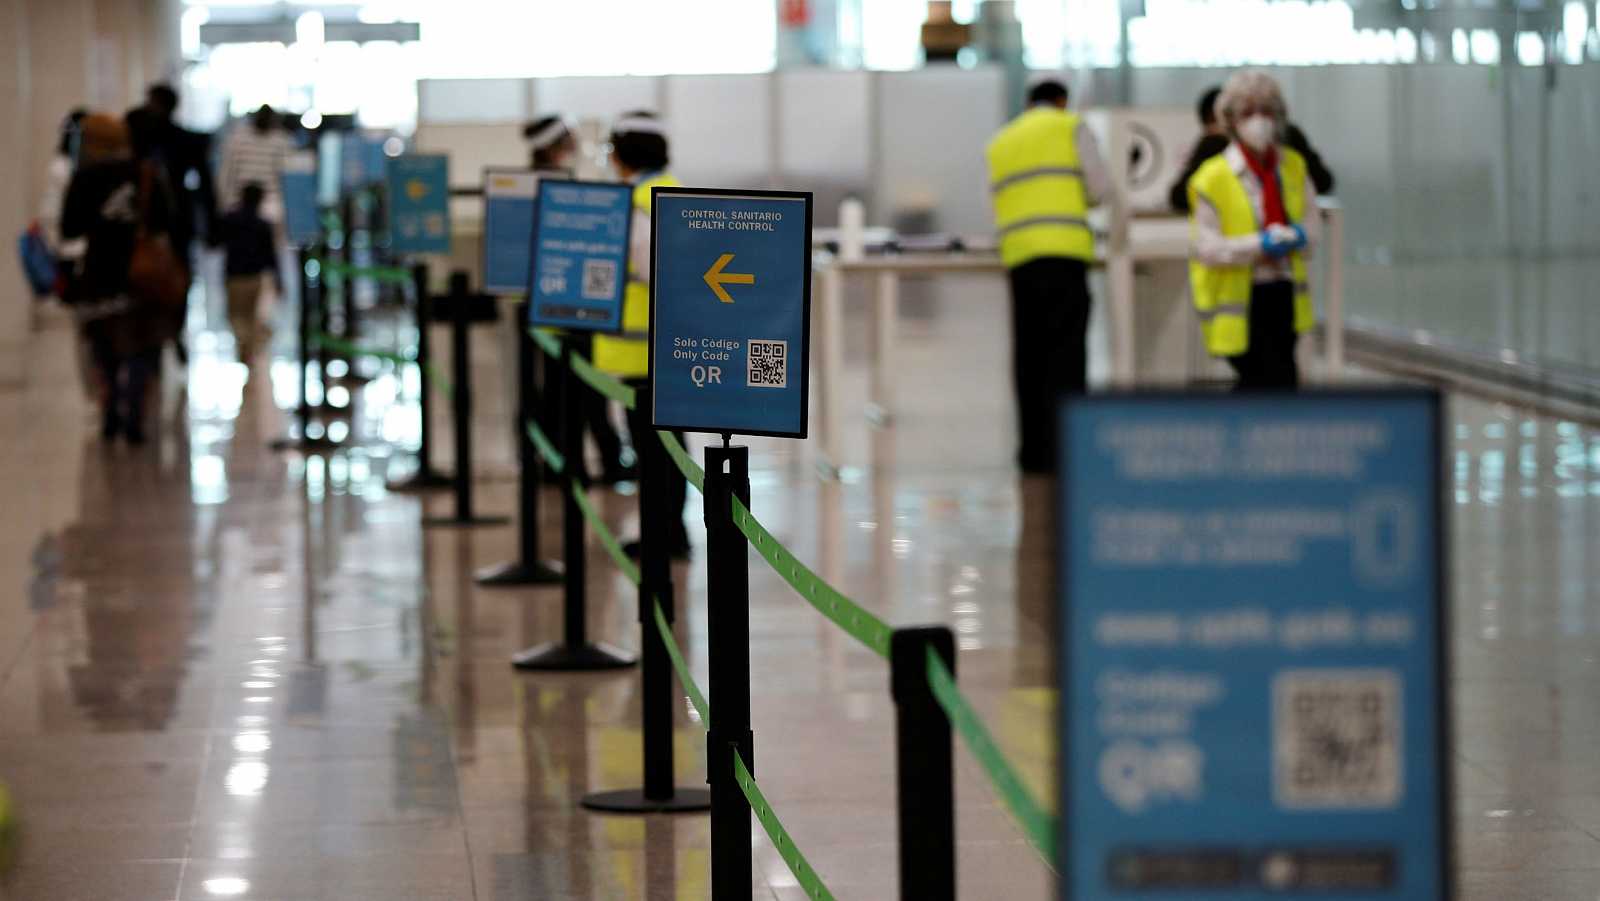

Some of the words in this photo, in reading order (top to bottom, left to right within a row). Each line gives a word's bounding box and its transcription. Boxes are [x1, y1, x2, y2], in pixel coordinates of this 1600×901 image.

[681, 209, 728, 220] CONTROL
[731, 210, 782, 221] SANITARIO
[688, 220, 725, 230] HEALTH
[728, 221, 775, 232] CONTROL
[674, 337, 698, 347] Solo
[673, 349, 698, 361] Only
[701, 350, 730, 361] Code
[690, 365, 722, 388] QR
[1099, 741, 1203, 812] QR
